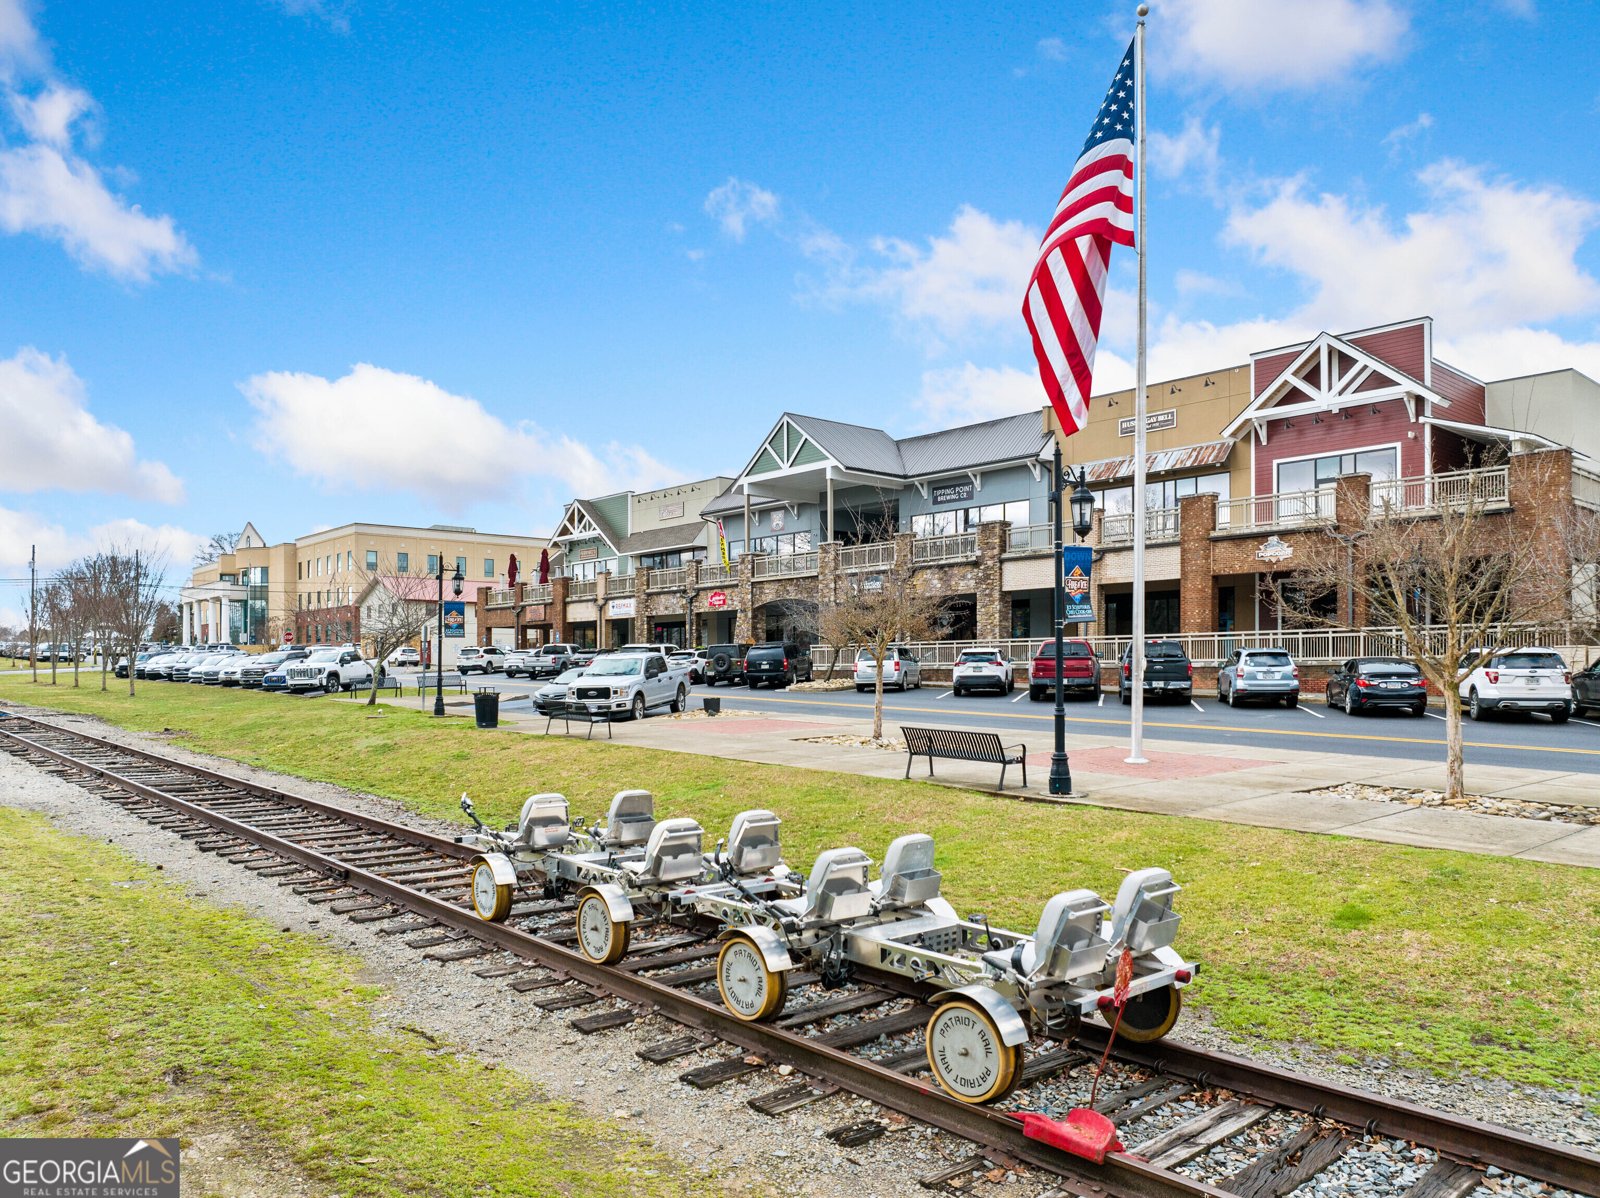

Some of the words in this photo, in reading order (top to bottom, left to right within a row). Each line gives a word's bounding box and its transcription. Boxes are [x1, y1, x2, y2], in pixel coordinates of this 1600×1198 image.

[934, 488, 955, 497] TIPPING
[955, 485, 972, 493] POINT
[937, 493, 959, 502] BREWING
[582, 910, 591, 947] PATRIOT
[600, 909, 610, 948] PATRIOT
[724, 961, 733, 982] RAIL
[733, 948, 762, 973] PATRIOT
[755, 976, 764, 998] RAIL
[727, 986, 755, 1009] PATRIOT
[939, 1015, 978, 1039] PATRIOT
[977, 1029, 993, 1059] RAIL
[938, 1045, 953, 1075] RAIL
[953, 1066, 992, 1089] PATRIOT
